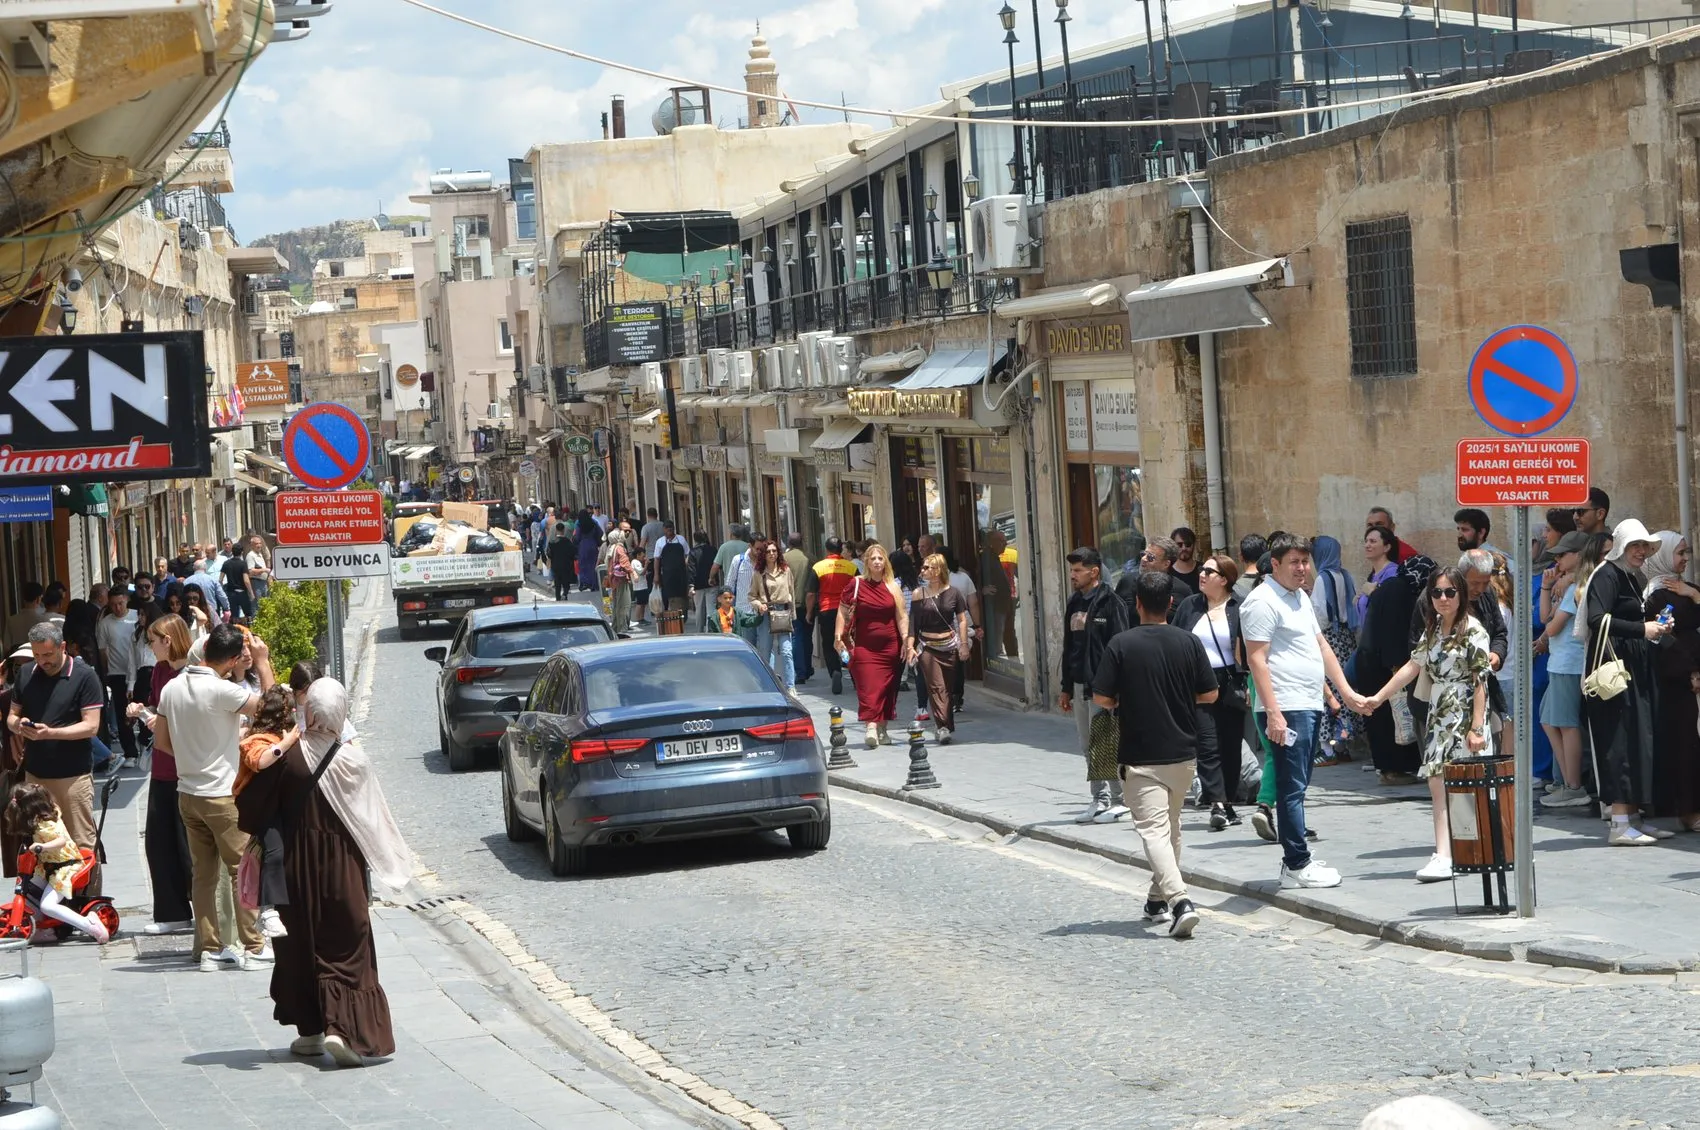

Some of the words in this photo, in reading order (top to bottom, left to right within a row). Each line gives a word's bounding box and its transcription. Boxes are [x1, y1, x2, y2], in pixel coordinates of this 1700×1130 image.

[622, 306, 655, 315] TERRACE
[0, 344, 170, 435] EN
[244, 393, 288, 402] ESTAURANT
[1466, 444, 1500, 454] 2025/1
[1503, 443, 1538, 453] SAYILI
[1540, 443, 1580, 453] UKOME
[0, 440, 140, 476] iamond
[1468, 460, 1510, 470] KARARI
[1512, 457, 1552, 469] GEREĞİ
[1556, 459, 1577, 468] YOL
[1460, 476, 1513, 486] BOYUNCA
[1516, 475, 1544, 484] PARK
[1547, 474, 1584, 484] ETMEK
[282, 496, 310, 504] 2025/1
[312, 495, 340, 504] SAYILI
[342, 494, 374, 503] UKOME
[1496, 490, 1550, 500] YASAKTIR
[285, 508, 318, 516] KARARI
[320, 506, 353, 516] GEREĞİ
[355, 507, 372, 515] YOL
[280, 521, 321, 529] BOYUNCA
[324, 520, 347, 528] PARK
[349, 520, 380, 528] ETMEK
[308, 532, 352, 541] YASAKTIR
[281, 557, 308, 568] YOL
[314, 553, 382, 568] BOYUNCA
[664, 744, 680, 758] 34
[686, 740, 708, 756] DEV
[716, 736, 739, 752] 939
